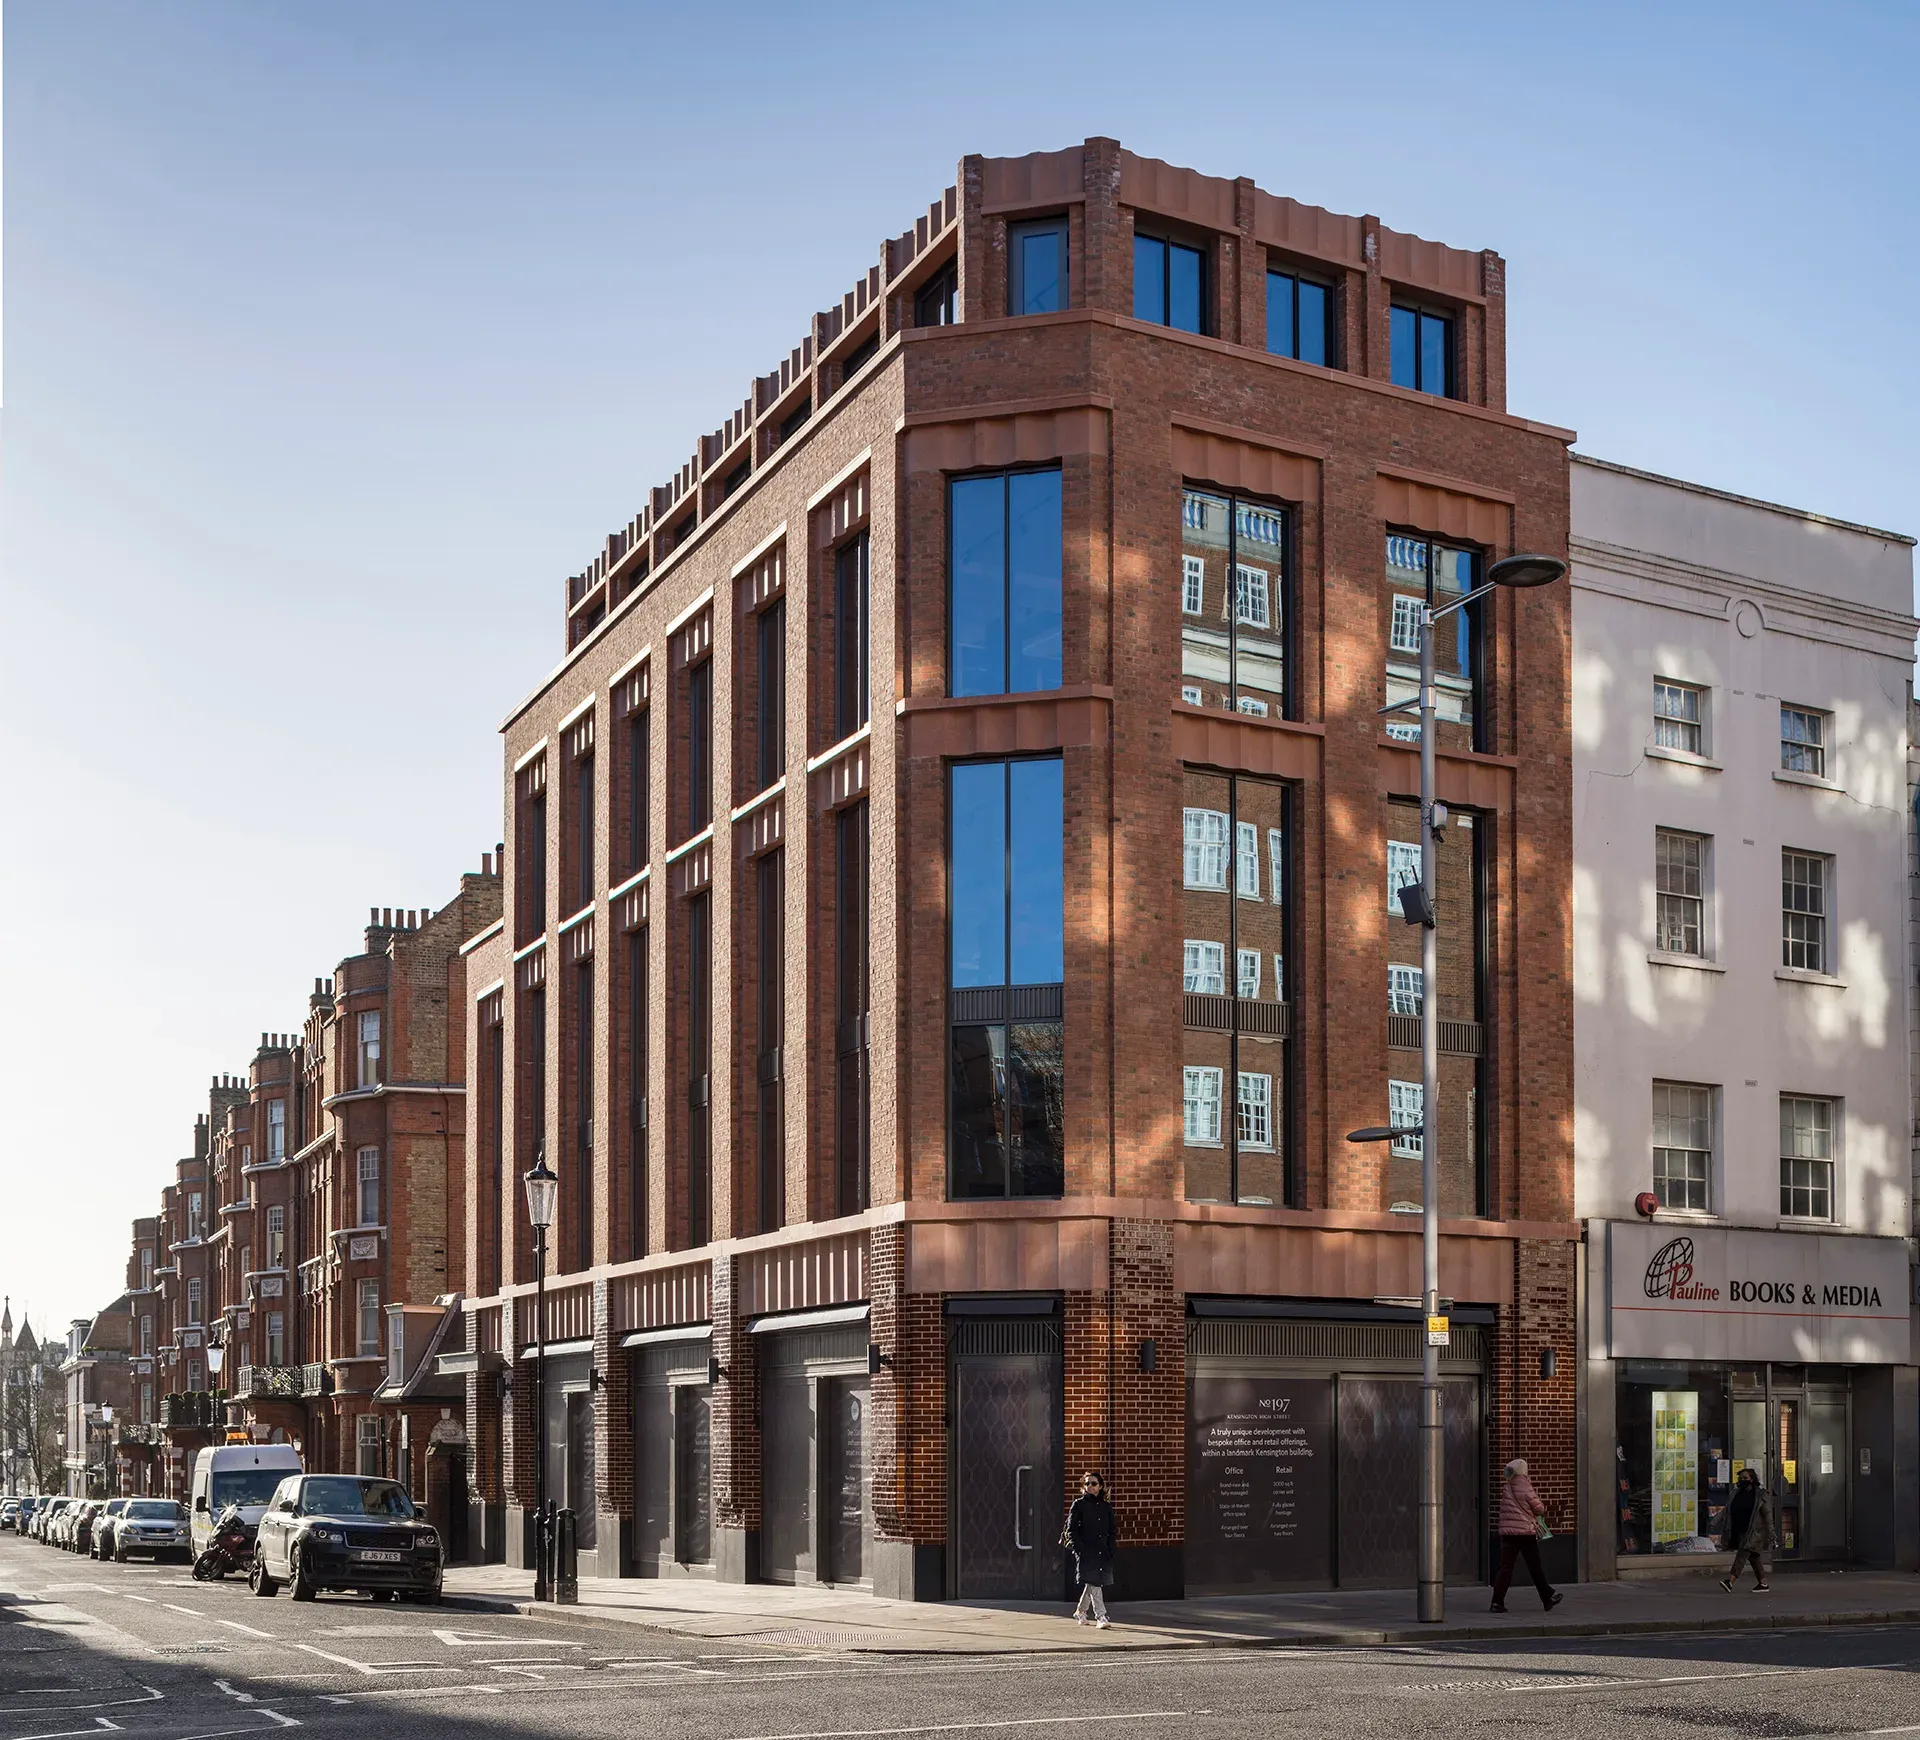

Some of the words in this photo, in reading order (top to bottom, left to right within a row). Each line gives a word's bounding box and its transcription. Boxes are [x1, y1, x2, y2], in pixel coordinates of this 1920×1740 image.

[1664, 1261, 1720, 1301] Pauline
[1729, 1280, 1795, 1304] BOOKS
[1801, 1284, 1816, 1305] &
[1822, 1285, 1882, 1307] MEDIA
[1211, 1428, 1216, 1436] A
[1217, 1428, 1231, 1437] truly
[1232, 1428, 1253, 1437] unique
[1253, 1428, 1292, 1437] development
[1292, 1427, 1306, 1435] with
[1207, 1438, 1233, 1447] bespoke
[1233, 1438, 1251, 1446] office
[1252, 1438, 1263, 1446] and
[1264, 1438, 1280, 1446] retail
[1201, 1449, 1221, 1457] within
[1226, 1449, 1255, 1457] landmark
[1255, 1449, 1288, 1458] Kensington
[1224, 1466, 1244, 1475] Office
[1275, 1465, 1293, 1474] Retail
[364, 1552, 383, 1560] EJ67
[384, 1553, 398, 1561] XES
